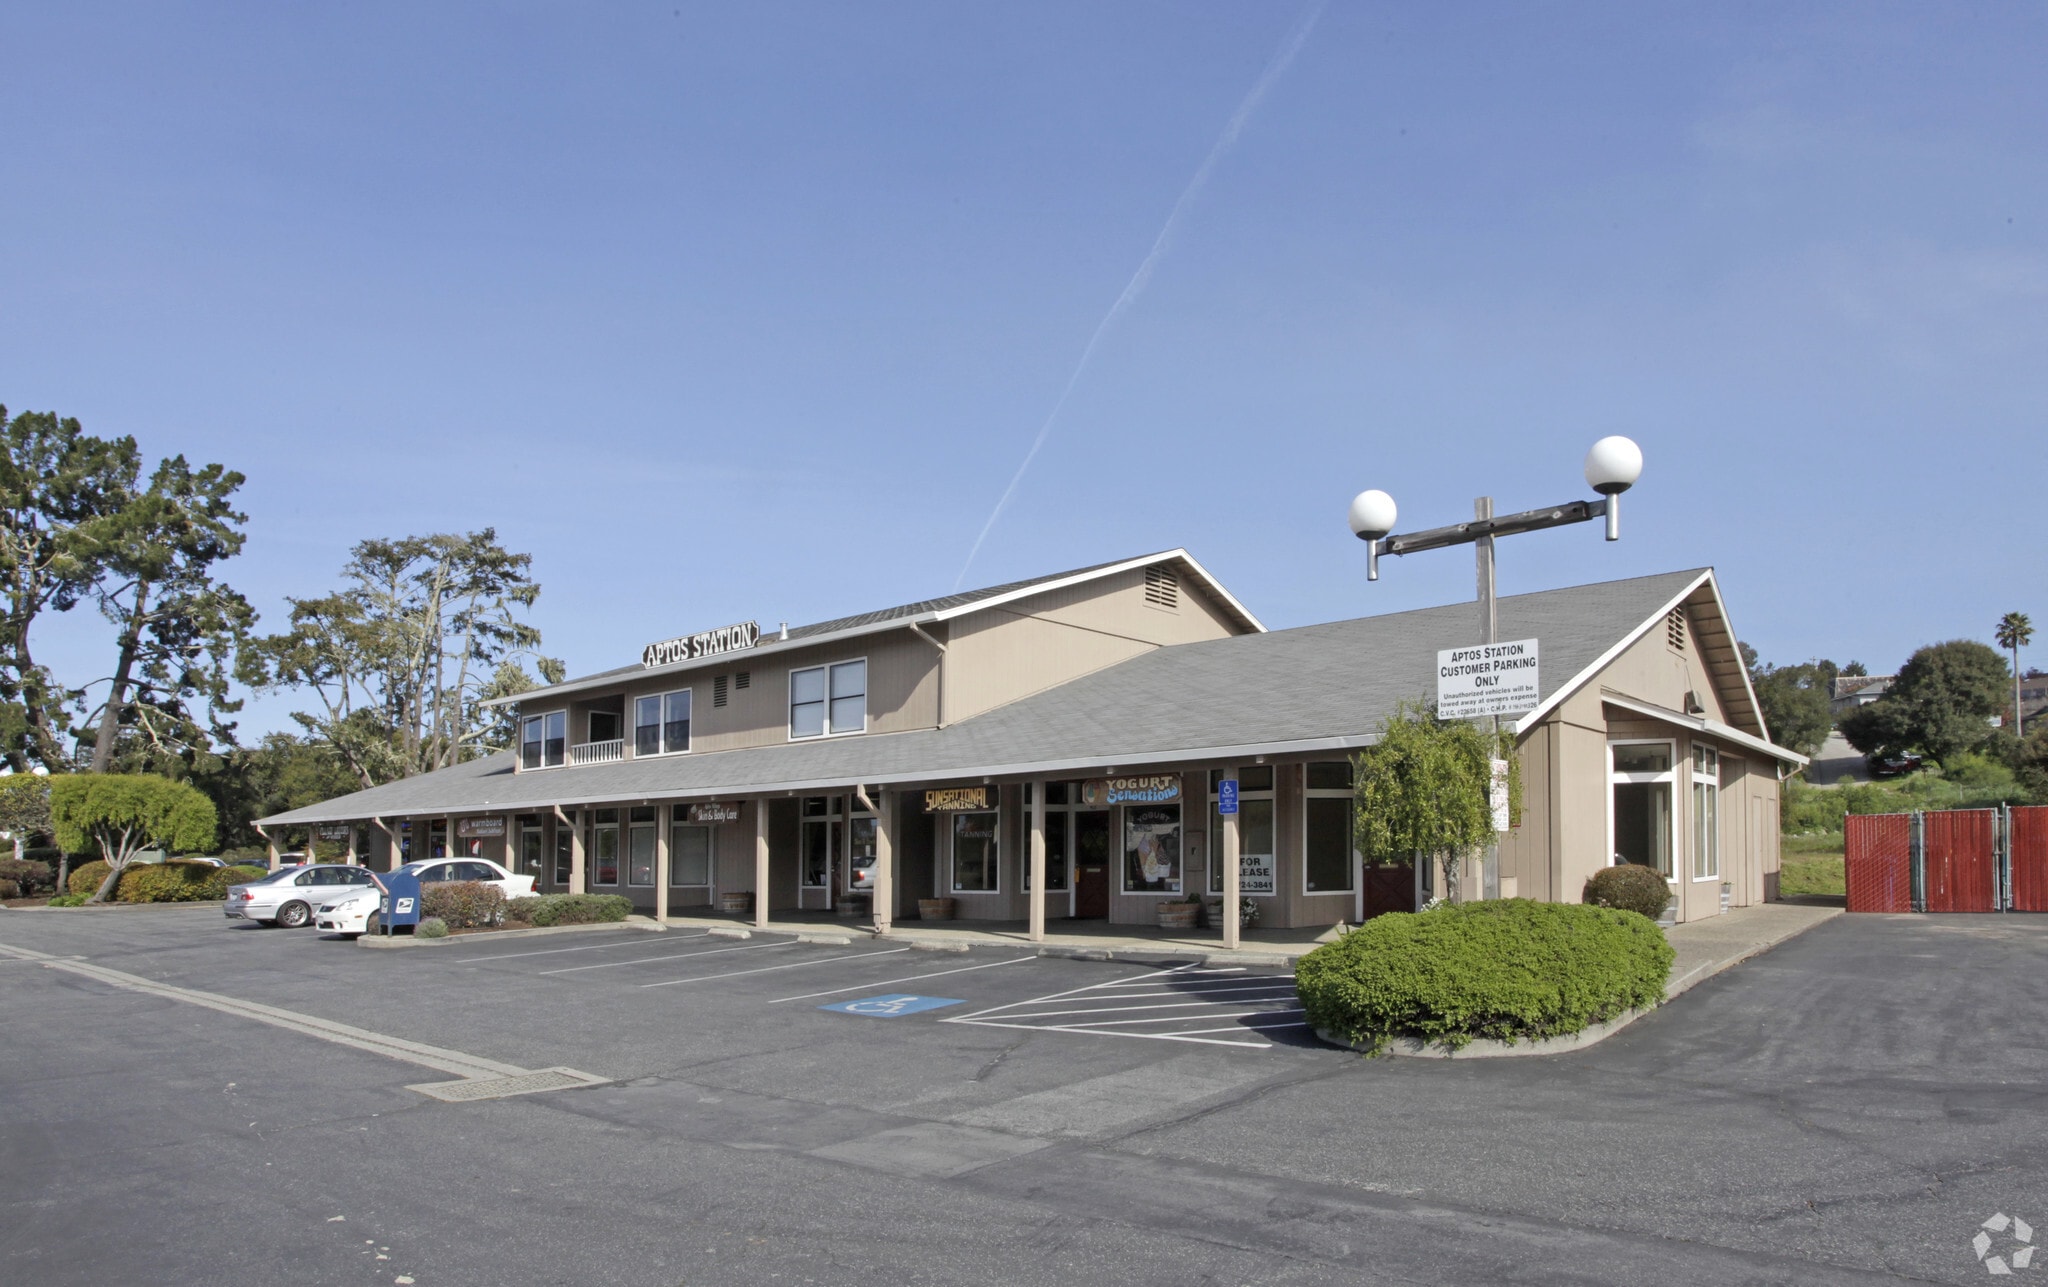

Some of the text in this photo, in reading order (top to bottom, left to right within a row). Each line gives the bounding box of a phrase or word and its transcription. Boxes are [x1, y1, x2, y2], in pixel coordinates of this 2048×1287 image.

[646, 623, 752, 666] APTOS STATION
[1451, 644, 1524, 662] APTOS STATION
[1440, 657, 1536, 677] CUSTOMER PARKING
[1475, 675, 1500, 687] ONLY
[1443, 690, 1484, 700] Unauthorized
[1485, 686, 1511, 696] vehicles
[1440, 700, 1459, 708] towed
[1460, 699, 1477, 708] away
[1486, 696, 1509, 704] owners
[1510, 693, 1538, 702] expense
[1106, 776, 1173, 790] YOGURT
[925, 787, 989, 811] SUNSATIONAL
[1106, 784, 1179, 804] Sensations
[936, 800, 977, 811] TANNING
[697, 807, 738, 823] Skin & Body Care
[1137, 811, 1171, 824] YOGURT
[471, 817, 503, 828] warmboard
[960, 831, 993, 839] TANNING
[1239, 857, 1261, 866] FOR
[1239, 867, 1270, 877] EASE
